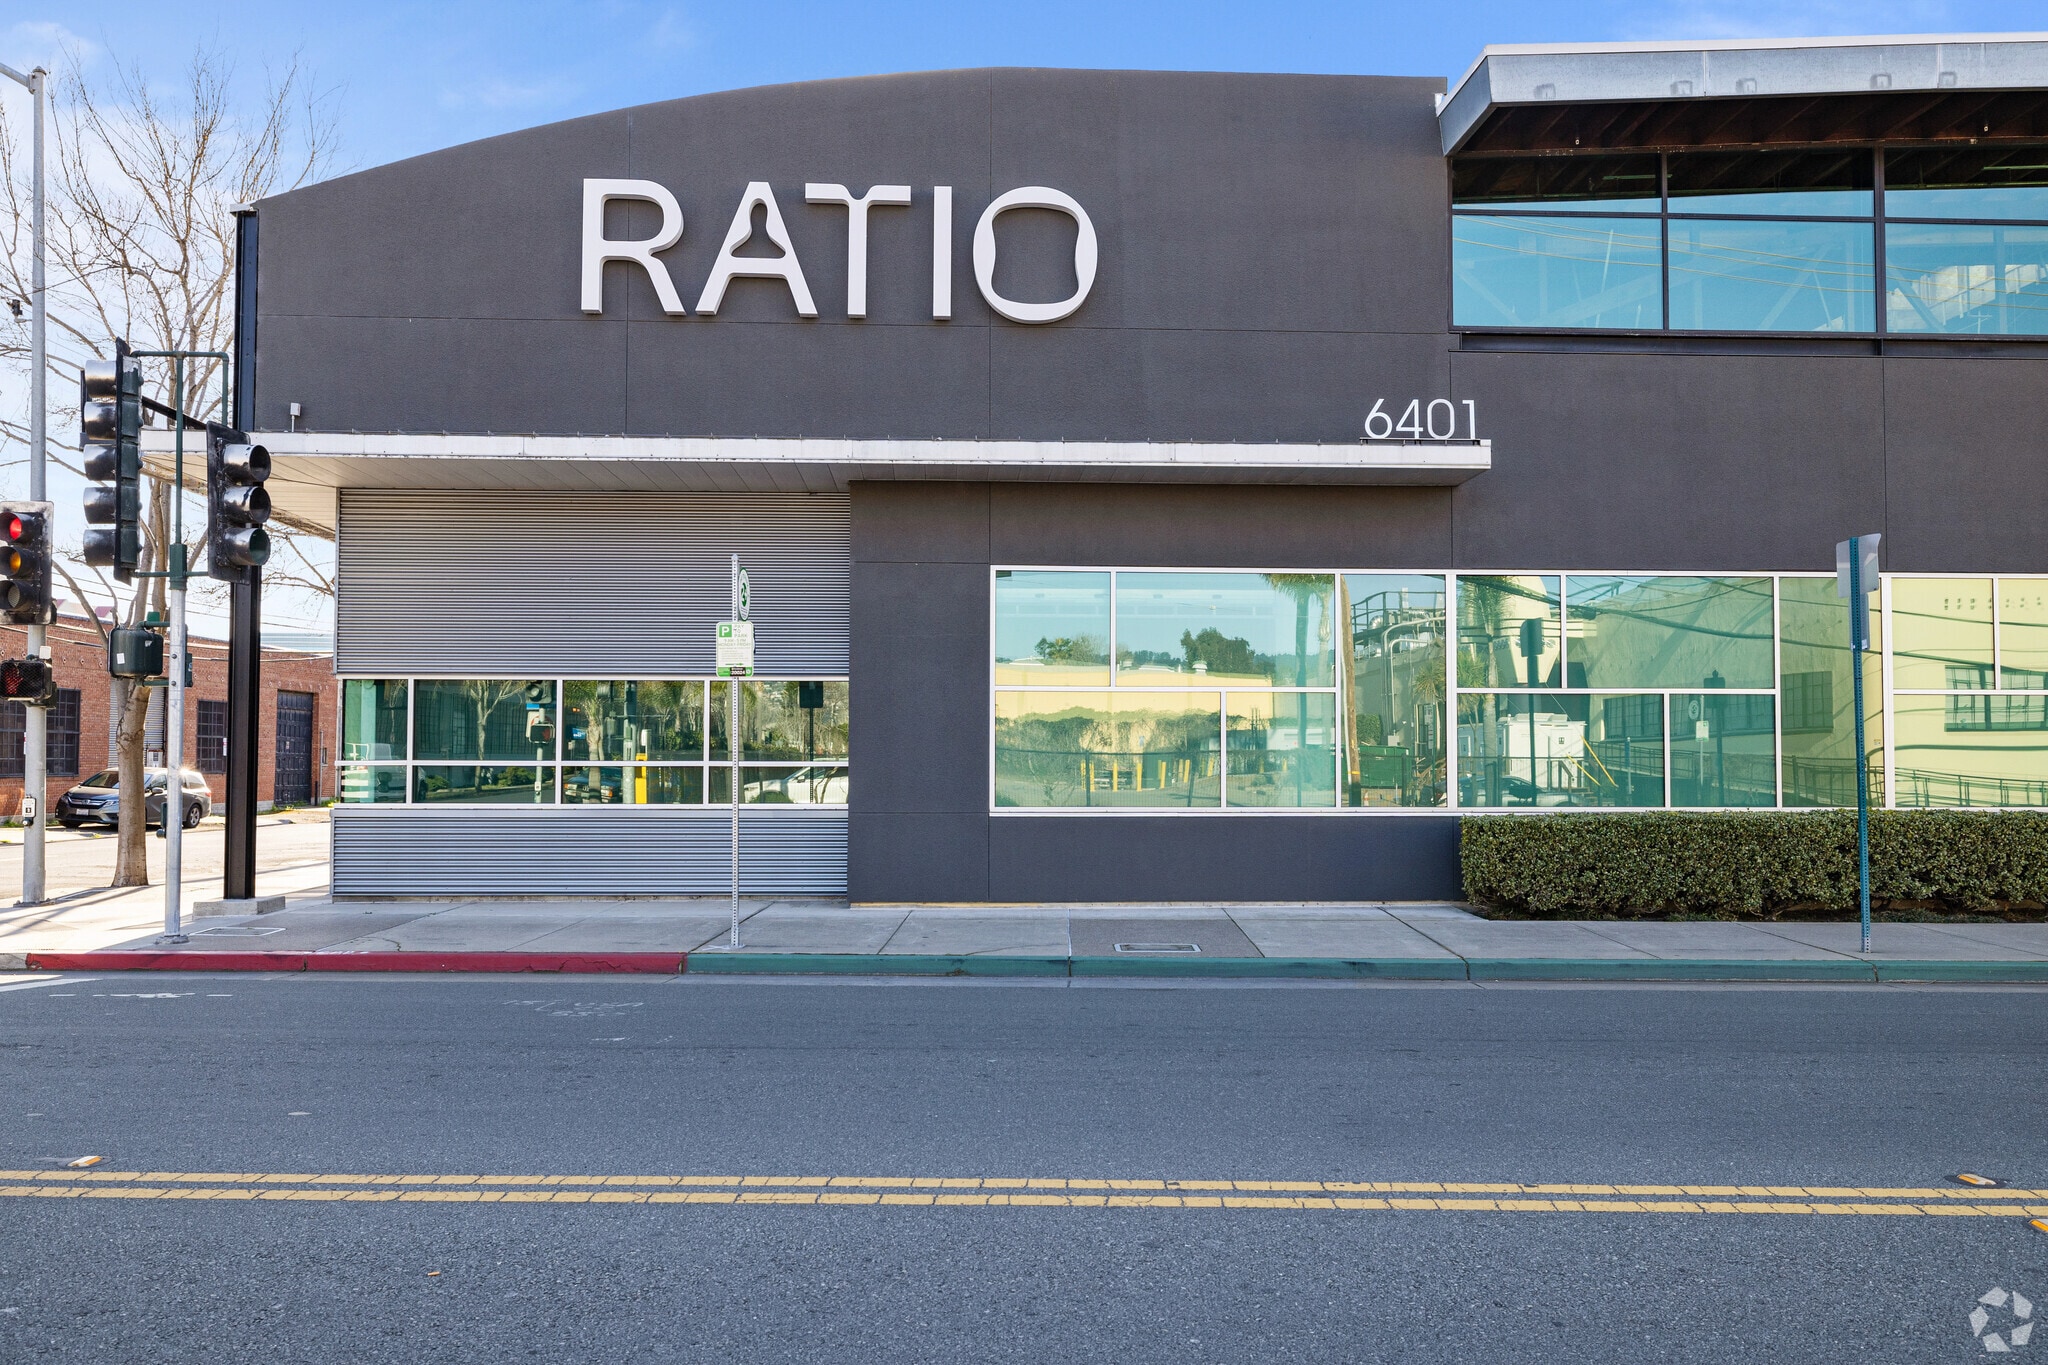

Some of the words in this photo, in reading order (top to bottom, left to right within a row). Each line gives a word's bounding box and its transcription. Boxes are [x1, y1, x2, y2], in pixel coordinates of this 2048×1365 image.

[581, 178, 1098, 324] RATIO
[1364, 398, 1476, 440] 6401
[721, 626, 730, 636] P
